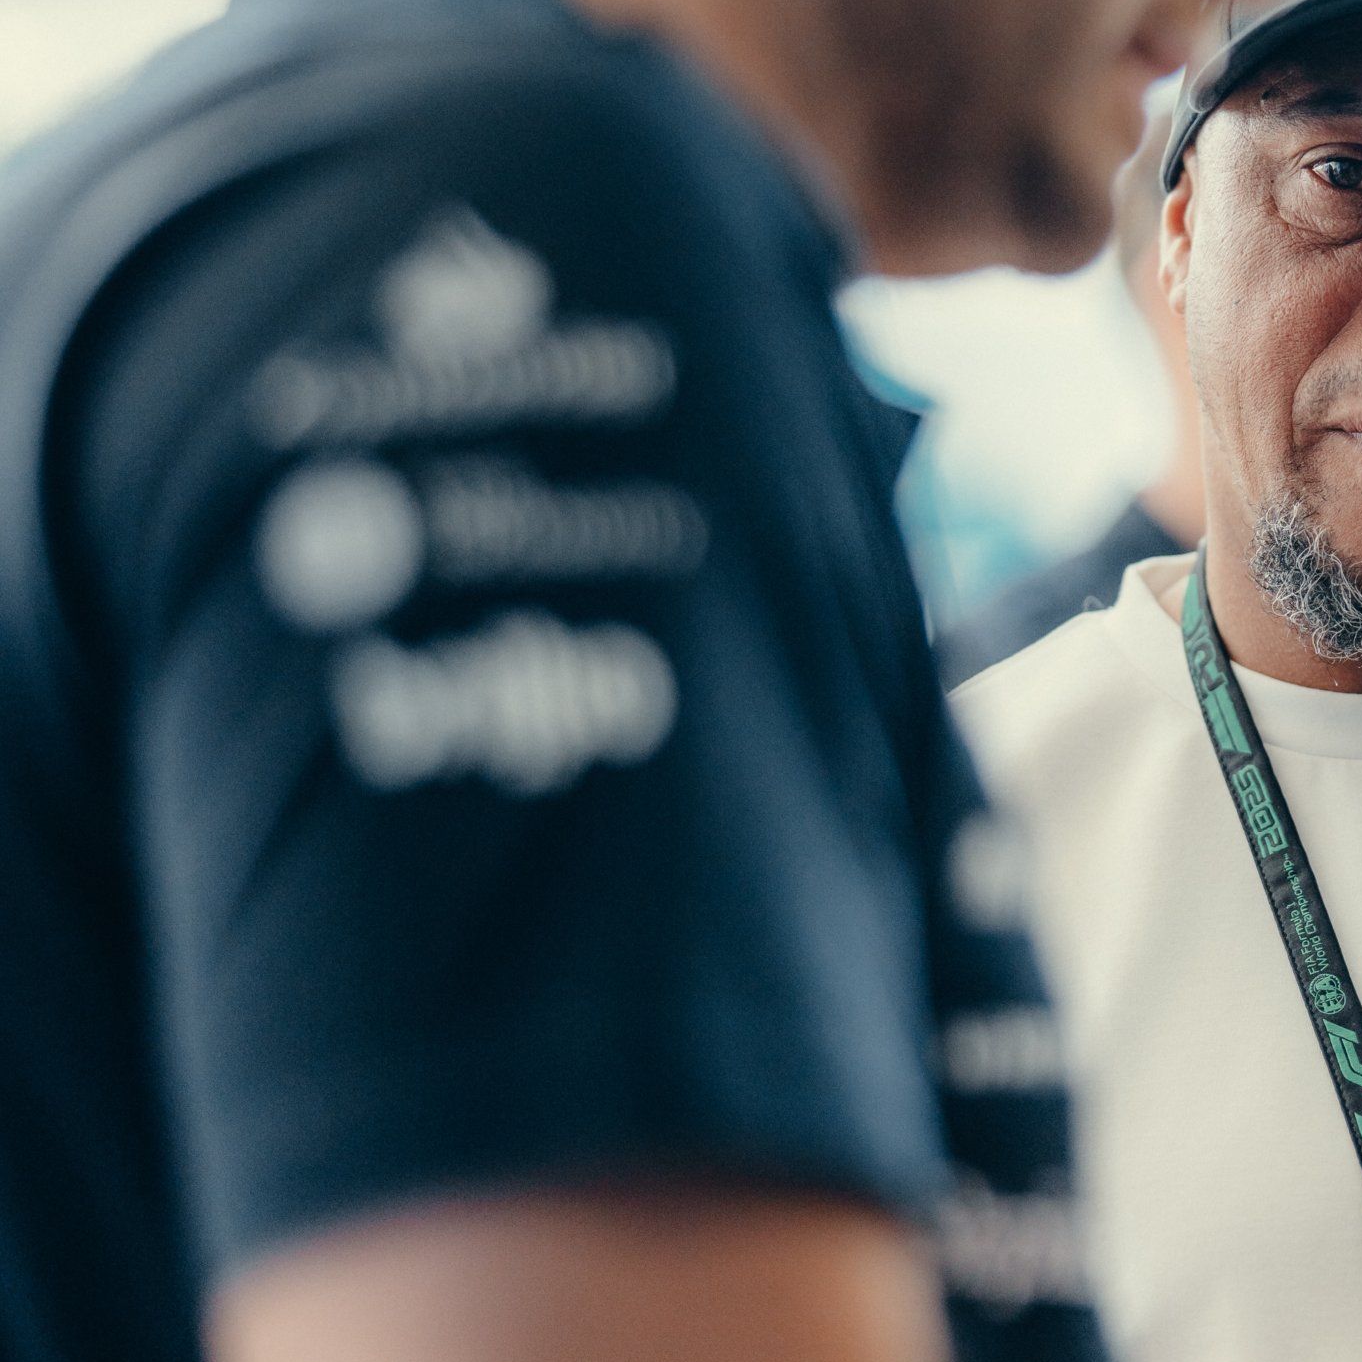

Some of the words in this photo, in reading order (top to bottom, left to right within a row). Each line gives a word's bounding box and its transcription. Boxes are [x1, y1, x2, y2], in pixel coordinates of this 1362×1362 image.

[1232, 764, 1289, 859] 2025
[1290, 908, 1313, 956] Formula
[1305, 954, 1320, 976] FIA
[1312, 935, 1329, 972] World
